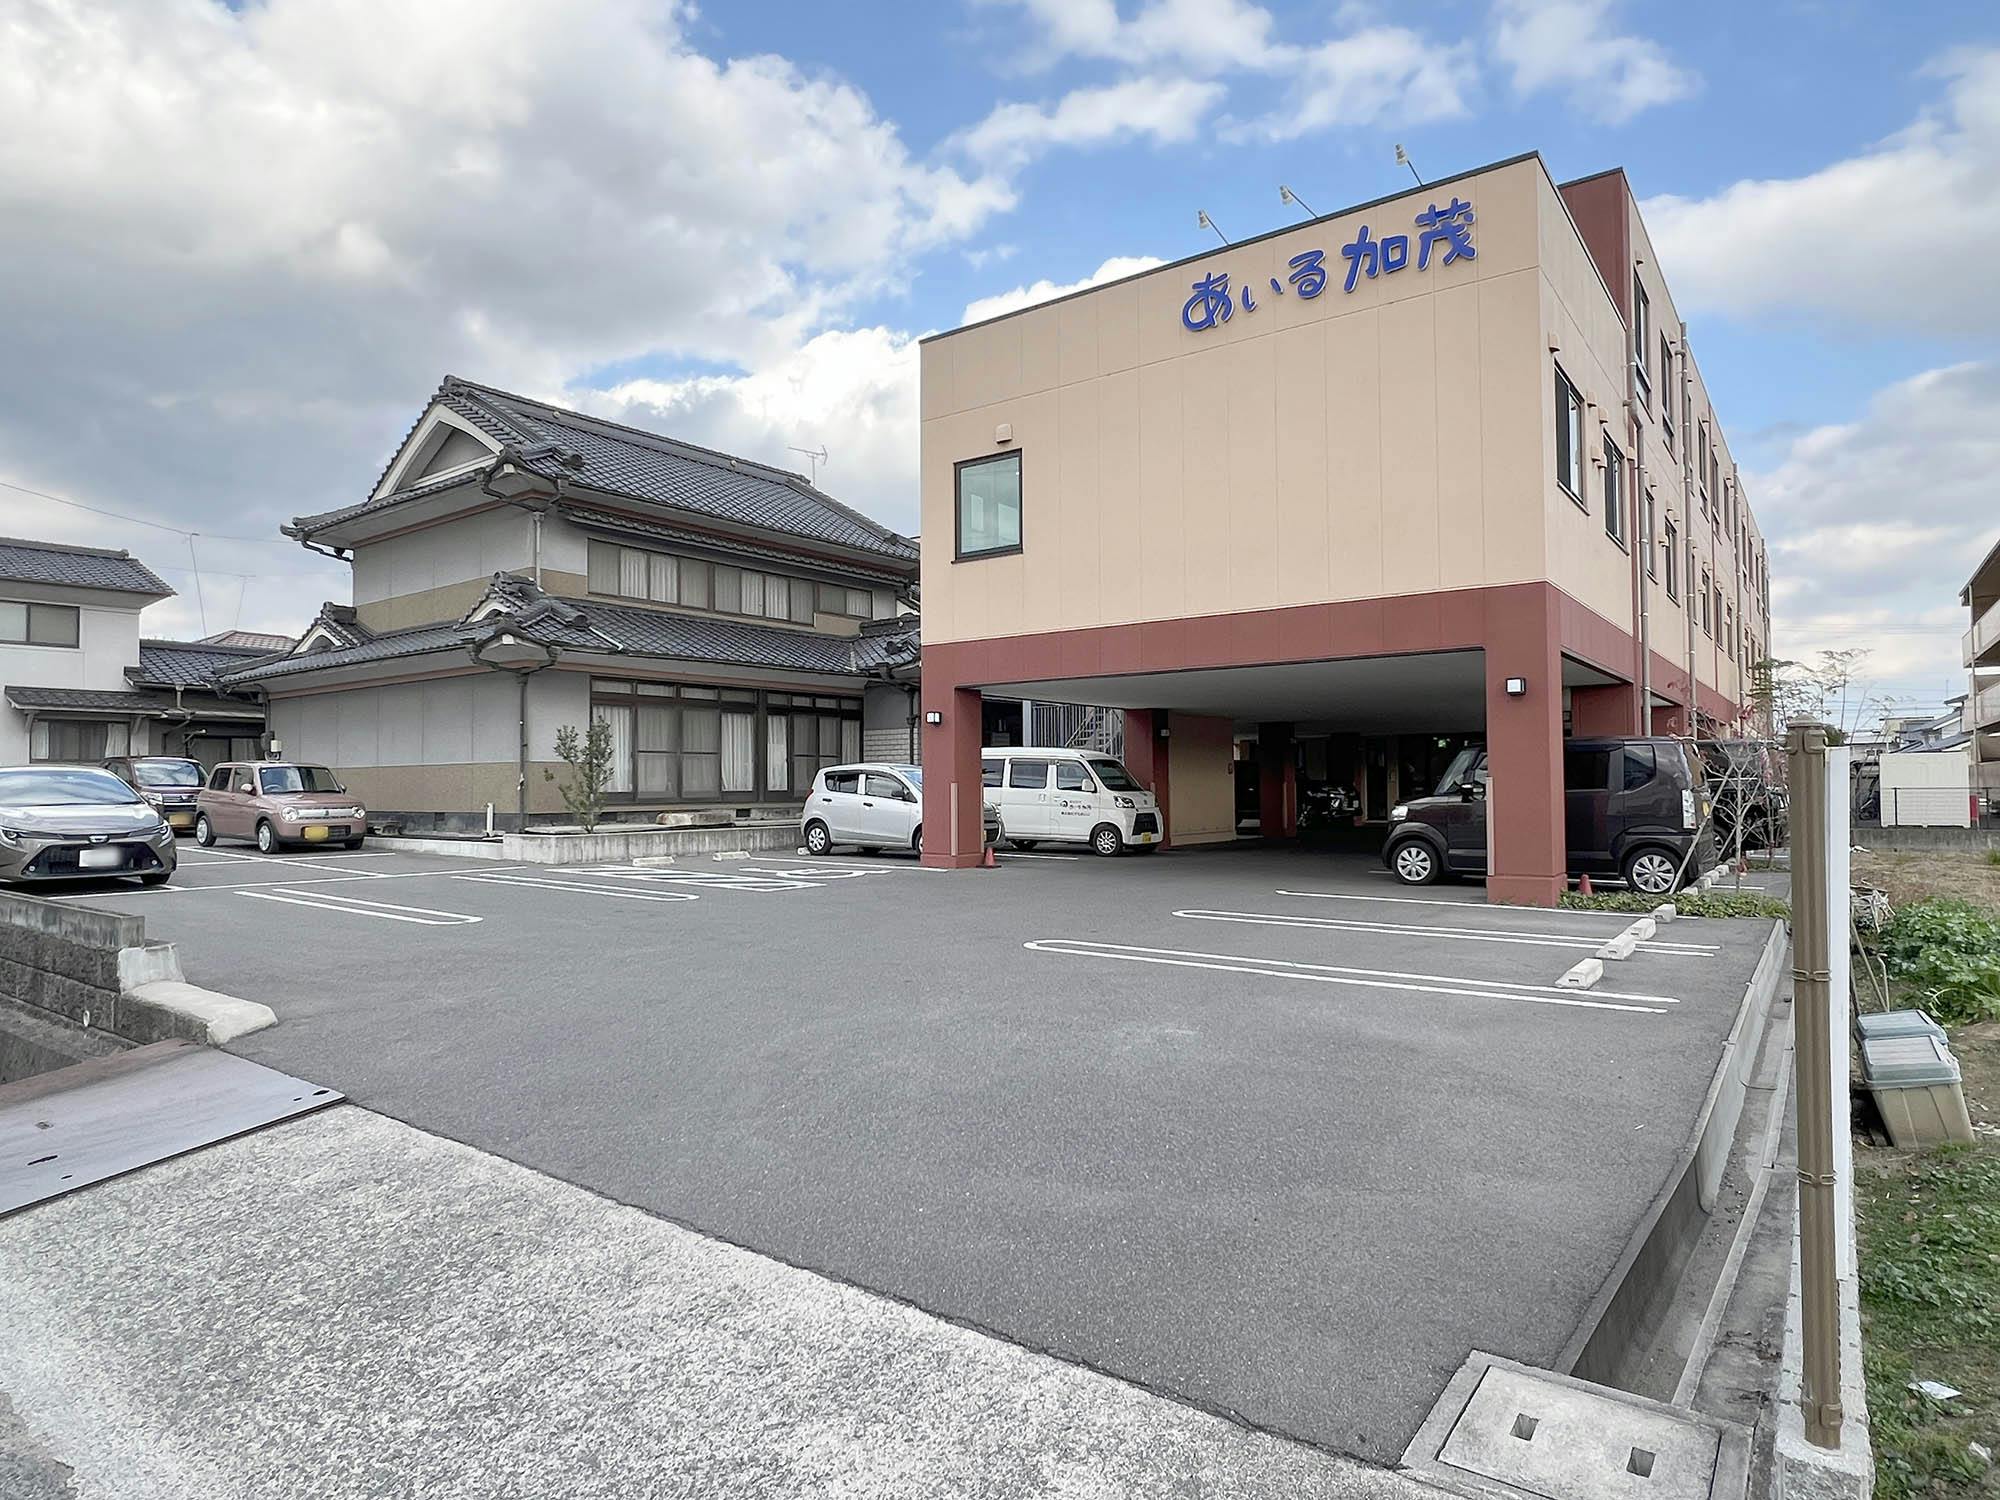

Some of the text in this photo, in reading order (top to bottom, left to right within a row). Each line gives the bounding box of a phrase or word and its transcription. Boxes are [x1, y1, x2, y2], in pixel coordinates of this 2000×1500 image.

[1181, 197, 1478, 331] あいる加茂
